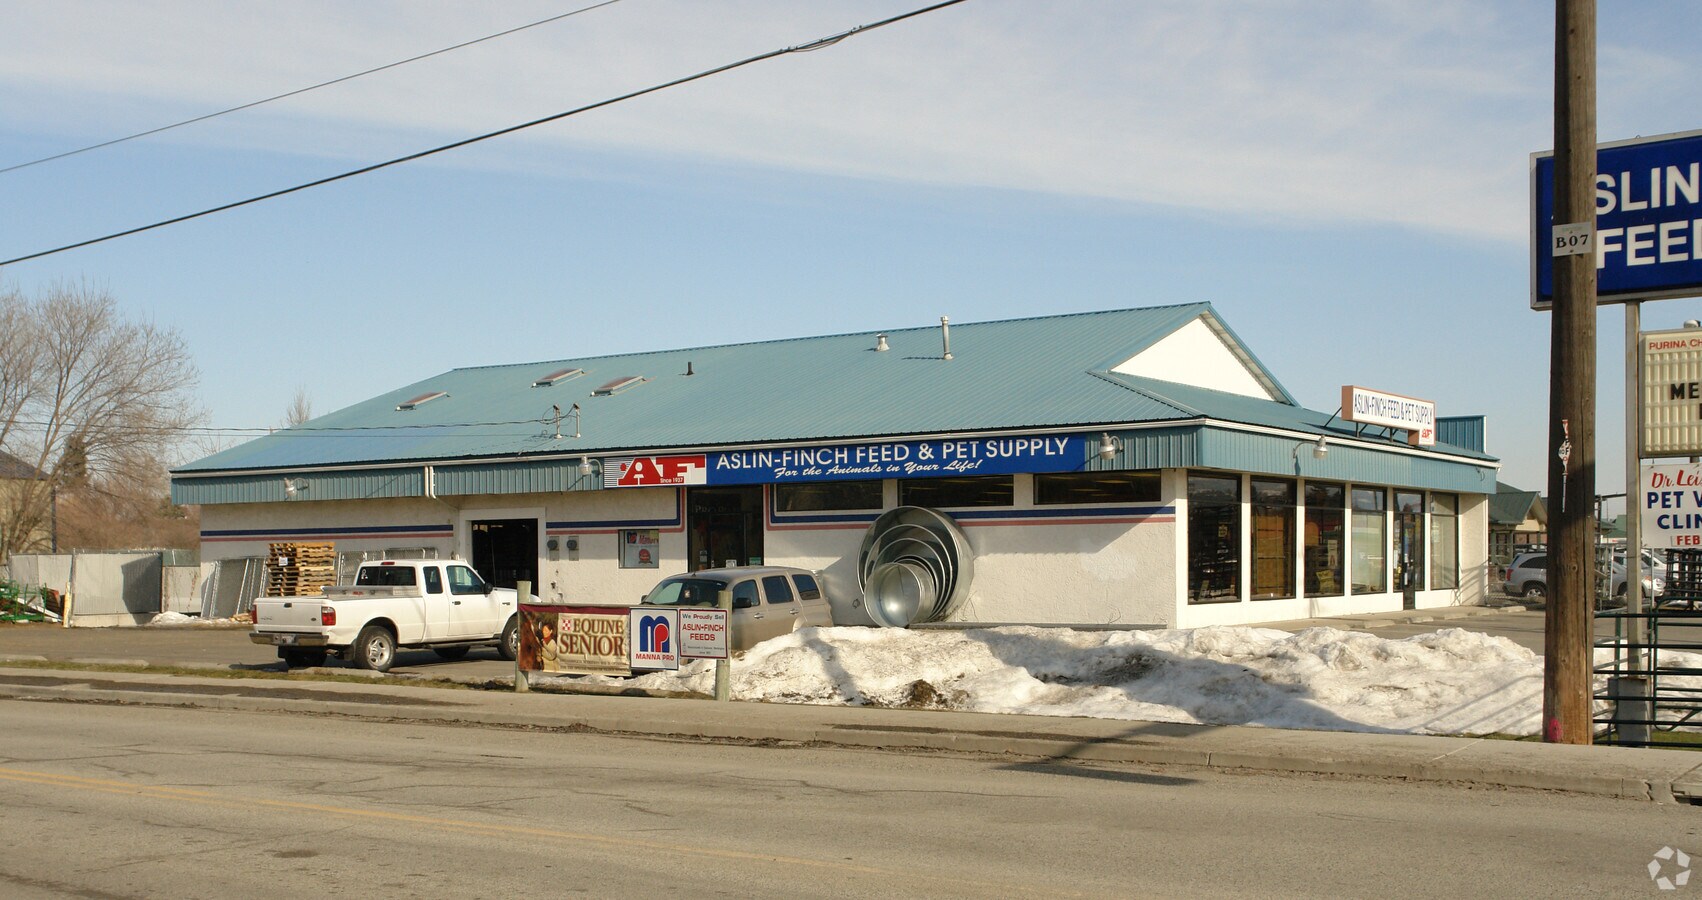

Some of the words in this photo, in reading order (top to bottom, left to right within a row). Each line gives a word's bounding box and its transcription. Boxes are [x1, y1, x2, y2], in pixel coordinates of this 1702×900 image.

[1596, 162, 1699, 215] SLIN
[1556, 234, 1588, 248] B07
[1649, 340, 1687, 350] PURINA
[1354, 393, 1386, 417] ASLIN-FINCH
[1387, 400, 1400, 419] FEED
[1401, 402, 1405, 420] &
[1405, 403, 1415, 421] PET
[1415, 404, 1433, 425] SUPPLY
[716, 448, 848, 469] ASLIN-FINCH
[856, 444, 910, 463] FEED
[918, 442, 935, 460] &
[943, 440, 979, 459] PET
[985, 437, 1069, 458] SUPPLY
[773, 467, 798, 479] For
[802, 466, 822, 476] the
[826, 463, 883, 476] Animals
[886, 463, 900, 472] in
[904, 461, 939, 474] Your
[943, 459, 983, 470] Life!
[1651, 472, 1675, 488] Dr.
[1647, 491, 1684, 508] PET
[1676, 534, 1700, 546] FEB
[572, 618, 624, 634] EQUINE
[559, 633, 626, 657] SENIOR
[690, 633, 715, 641] FEEDS
[635, 653, 661, 661] MANNA
